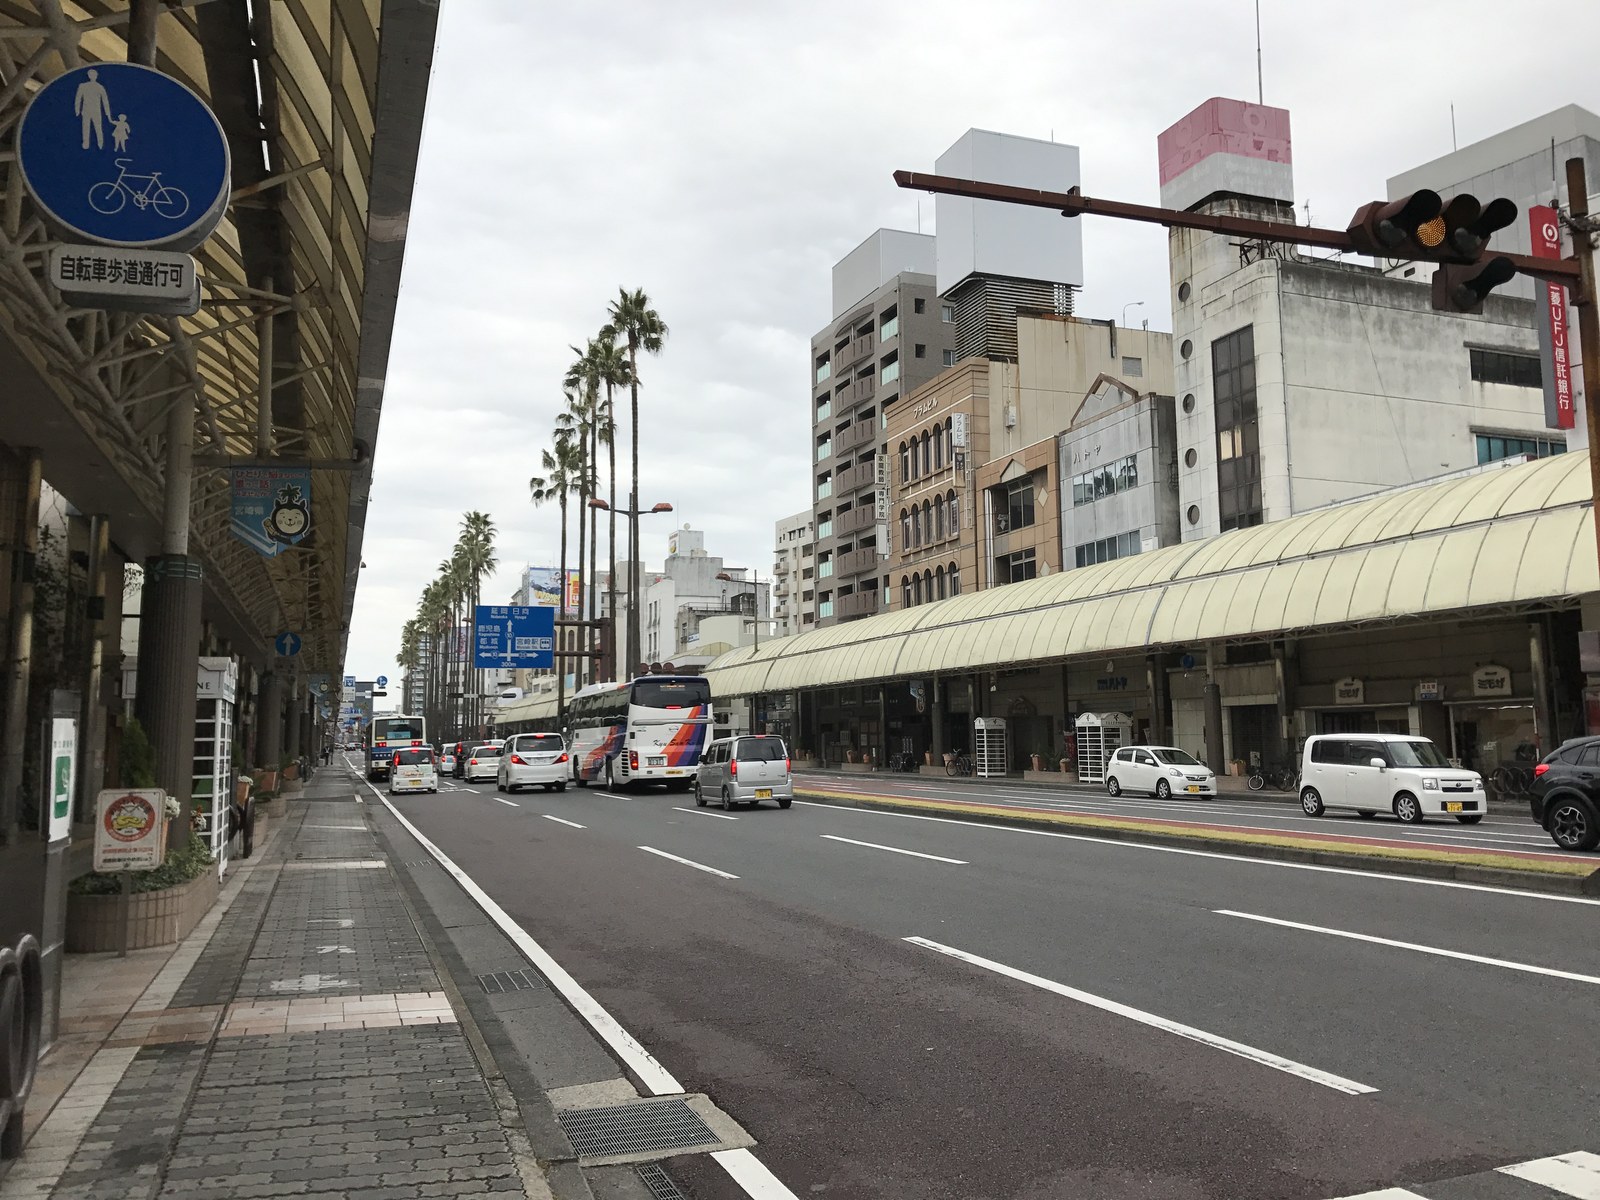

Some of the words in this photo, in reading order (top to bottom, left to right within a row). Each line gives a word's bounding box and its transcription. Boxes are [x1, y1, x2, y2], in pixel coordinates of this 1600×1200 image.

[61, 254, 184, 288] 自転車歩道通行可
[913, 397, 939, 419] プラムビル
[1073, 444, 1102, 465] ハトヤ
